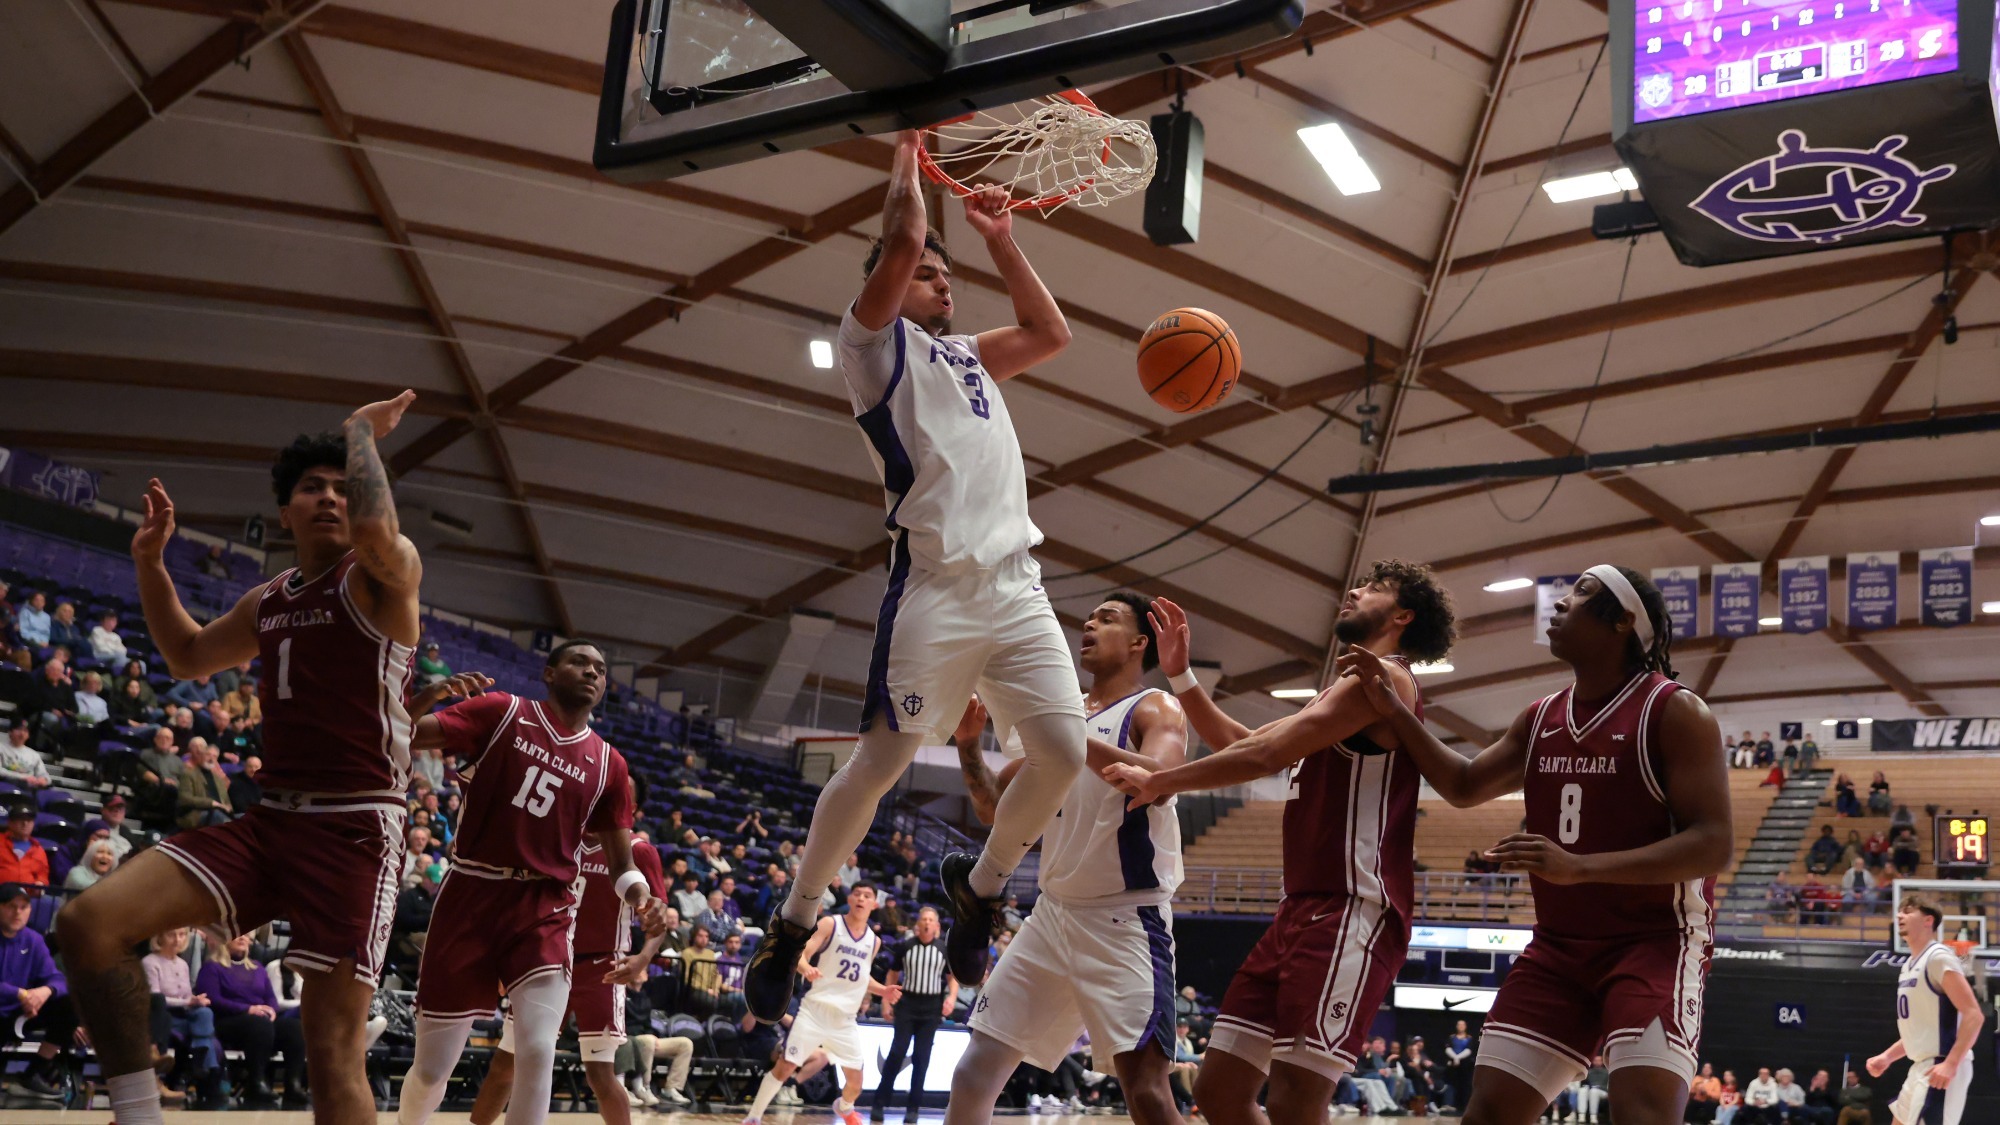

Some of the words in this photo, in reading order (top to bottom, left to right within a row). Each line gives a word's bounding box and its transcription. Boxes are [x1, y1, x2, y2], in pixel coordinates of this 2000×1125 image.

[964, 373, 990, 420] 3
[260, 612, 291, 634] SANTA
[291, 608, 335, 627] CLARA
[277, 637, 293, 700] 1
[1786, 725, 1797, 737] 7
[1842, 724, 1852, 736] 8
[1913, 720, 1962, 747] WE
[513, 736, 550, 765] SANTA
[551, 755, 586, 784] CLARA
[1538, 756, 1573, 773] SANTA
[1575, 756, 1617, 774] CLARA
[511, 765, 564, 818] 15
[1558, 783, 1583, 844] 8
[1956, 834, 1983, 860] 19
[582, 862, 609, 875] CLARA
[836, 959, 861, 982] 23
[1778, 1006, 1802, 1024] 8A
